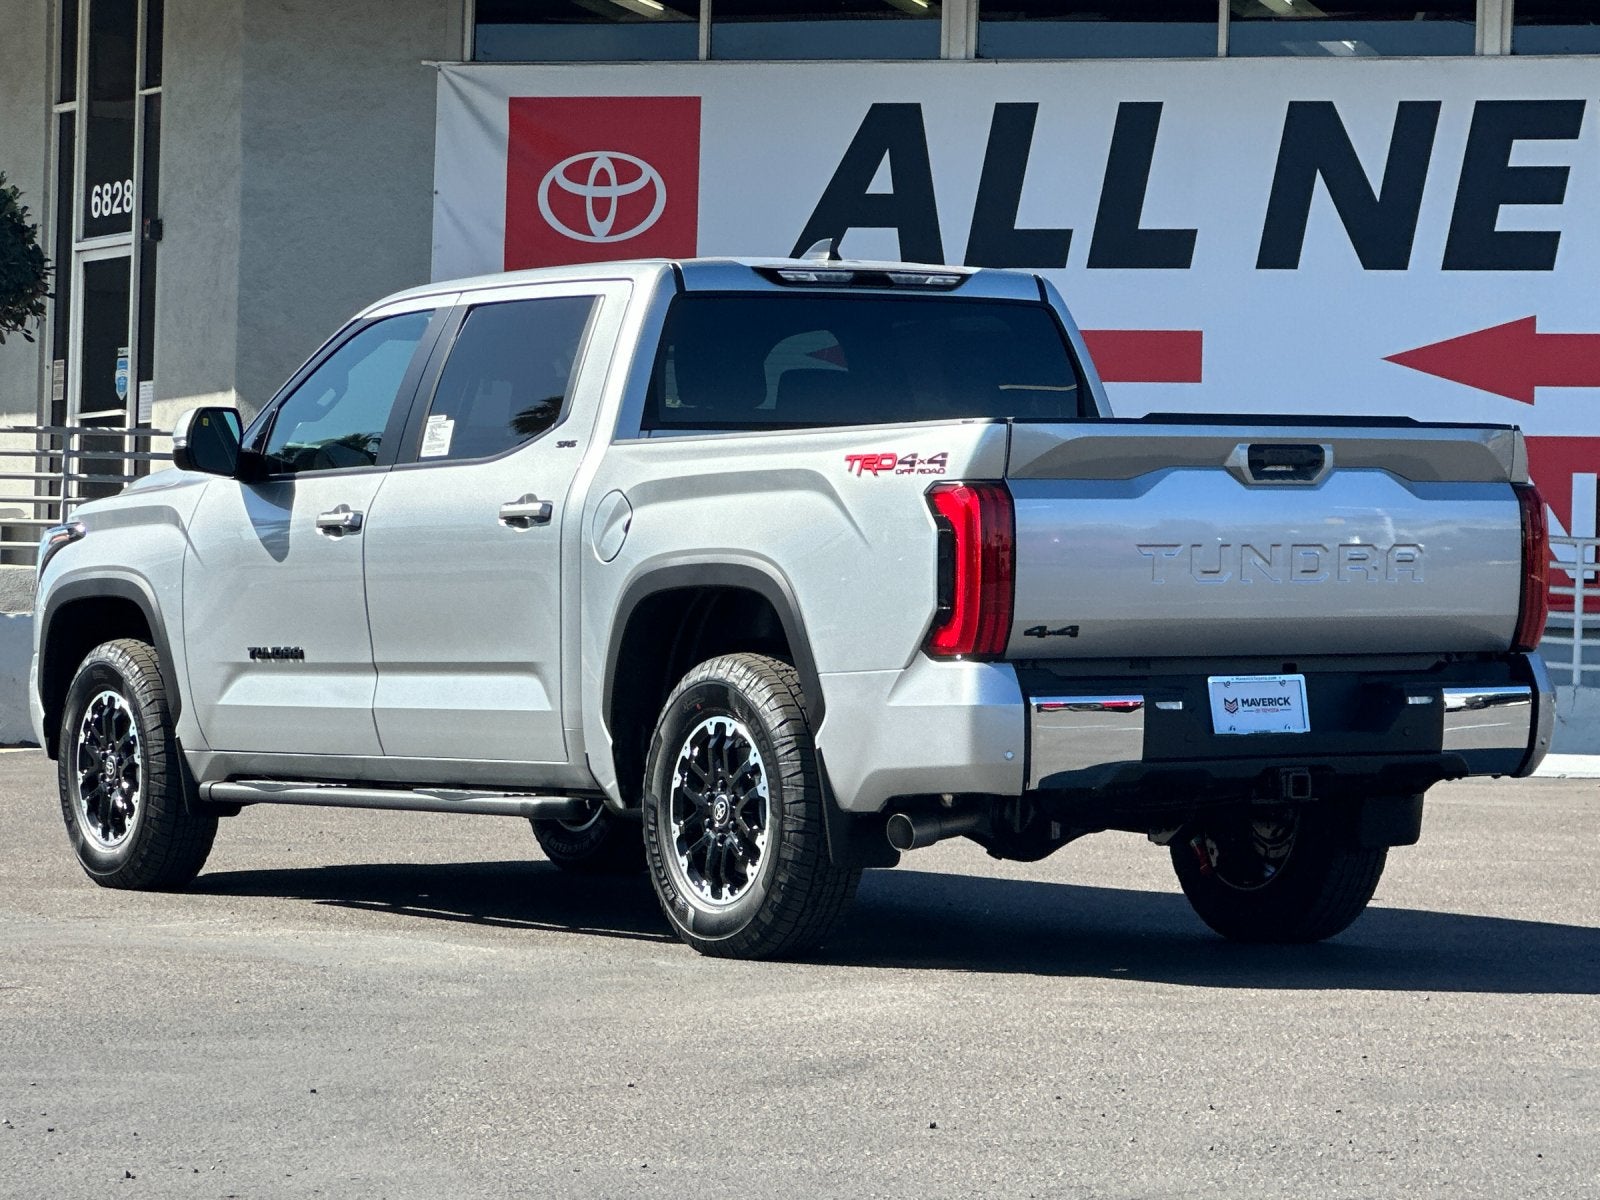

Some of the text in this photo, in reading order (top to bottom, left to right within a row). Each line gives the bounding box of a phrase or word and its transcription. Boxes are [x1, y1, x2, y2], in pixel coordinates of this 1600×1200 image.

[91, 179, 133, 218] 6828
[789, 99, 1600, 270] ALL NE
[845, 453, 897, 477] TRD
[916, 467, 946, 475] ROAD
[1136, 543, 1424, 584] TUNDRA
[1241, 697, 1291, 707] MAVERICK
